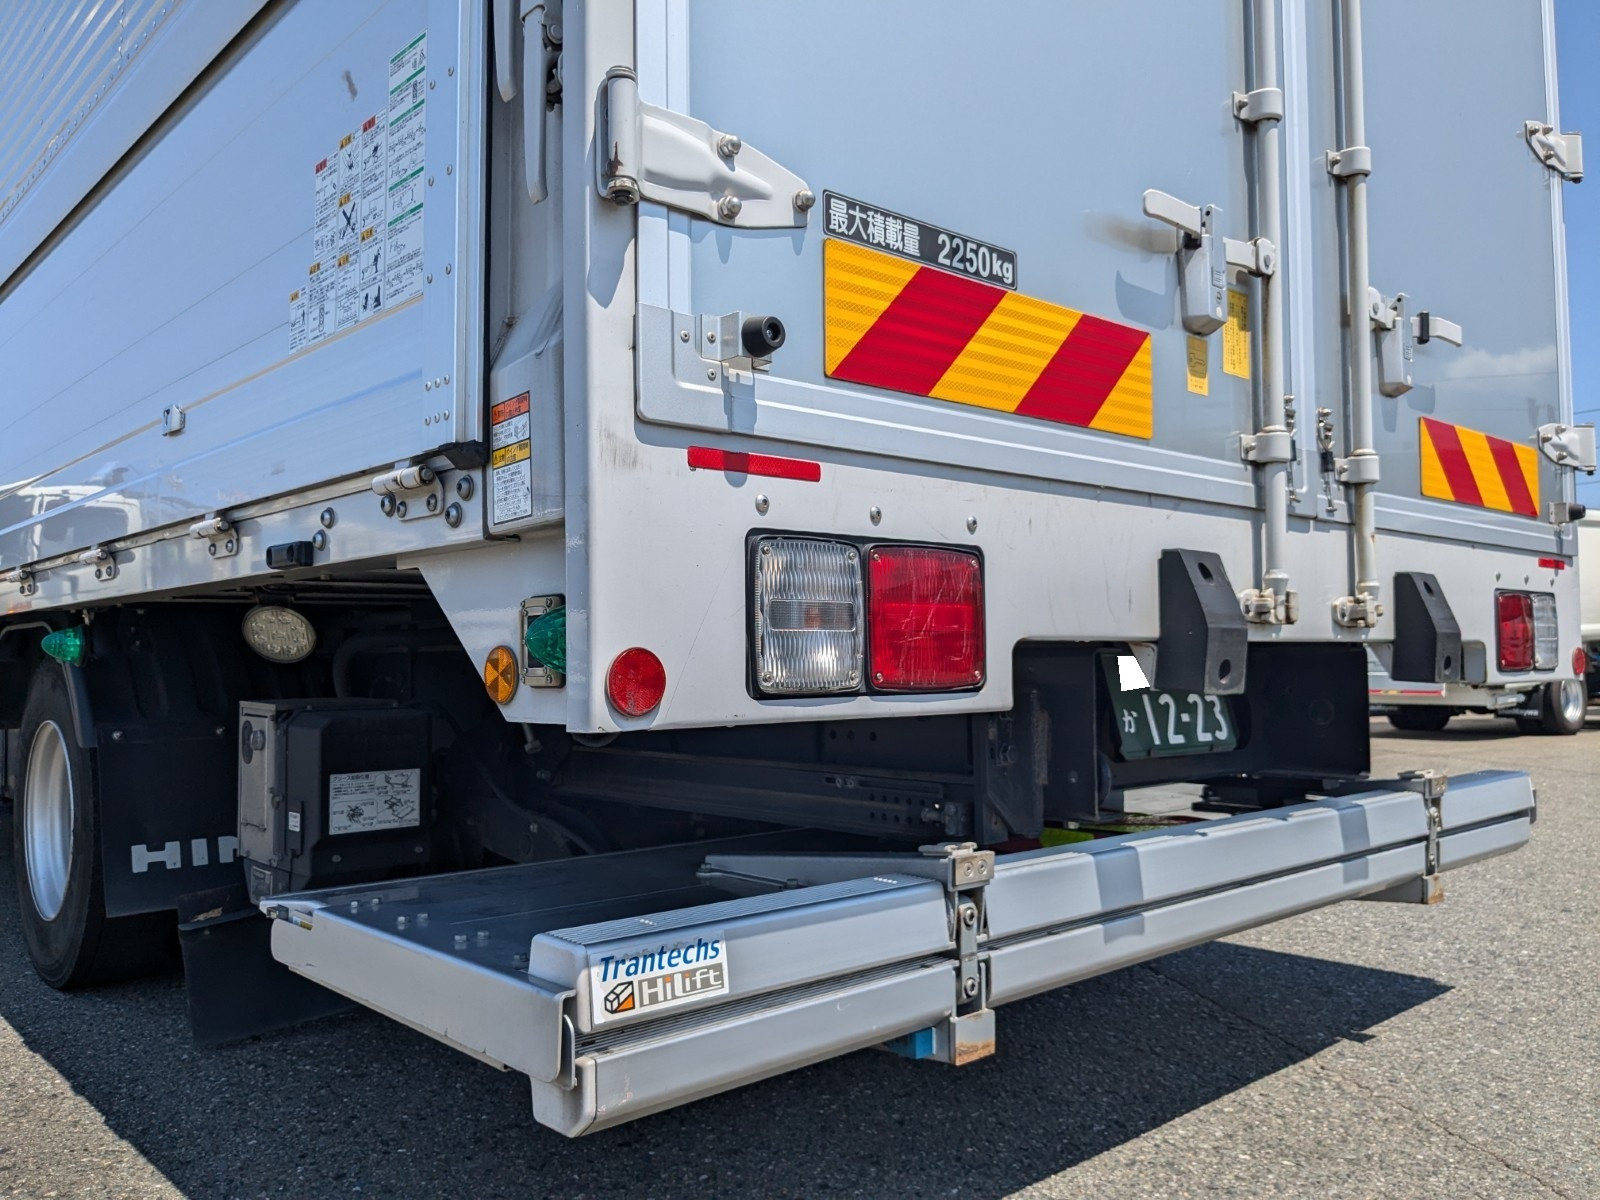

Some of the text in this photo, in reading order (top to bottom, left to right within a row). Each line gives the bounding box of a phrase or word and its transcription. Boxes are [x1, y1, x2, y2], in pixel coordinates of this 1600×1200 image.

[829, 198, 1013, 284] 最大積載量 2250kg
[1142, 693, 1228, 745] 12-23
[600, 937, 720, 982] Trantechs
